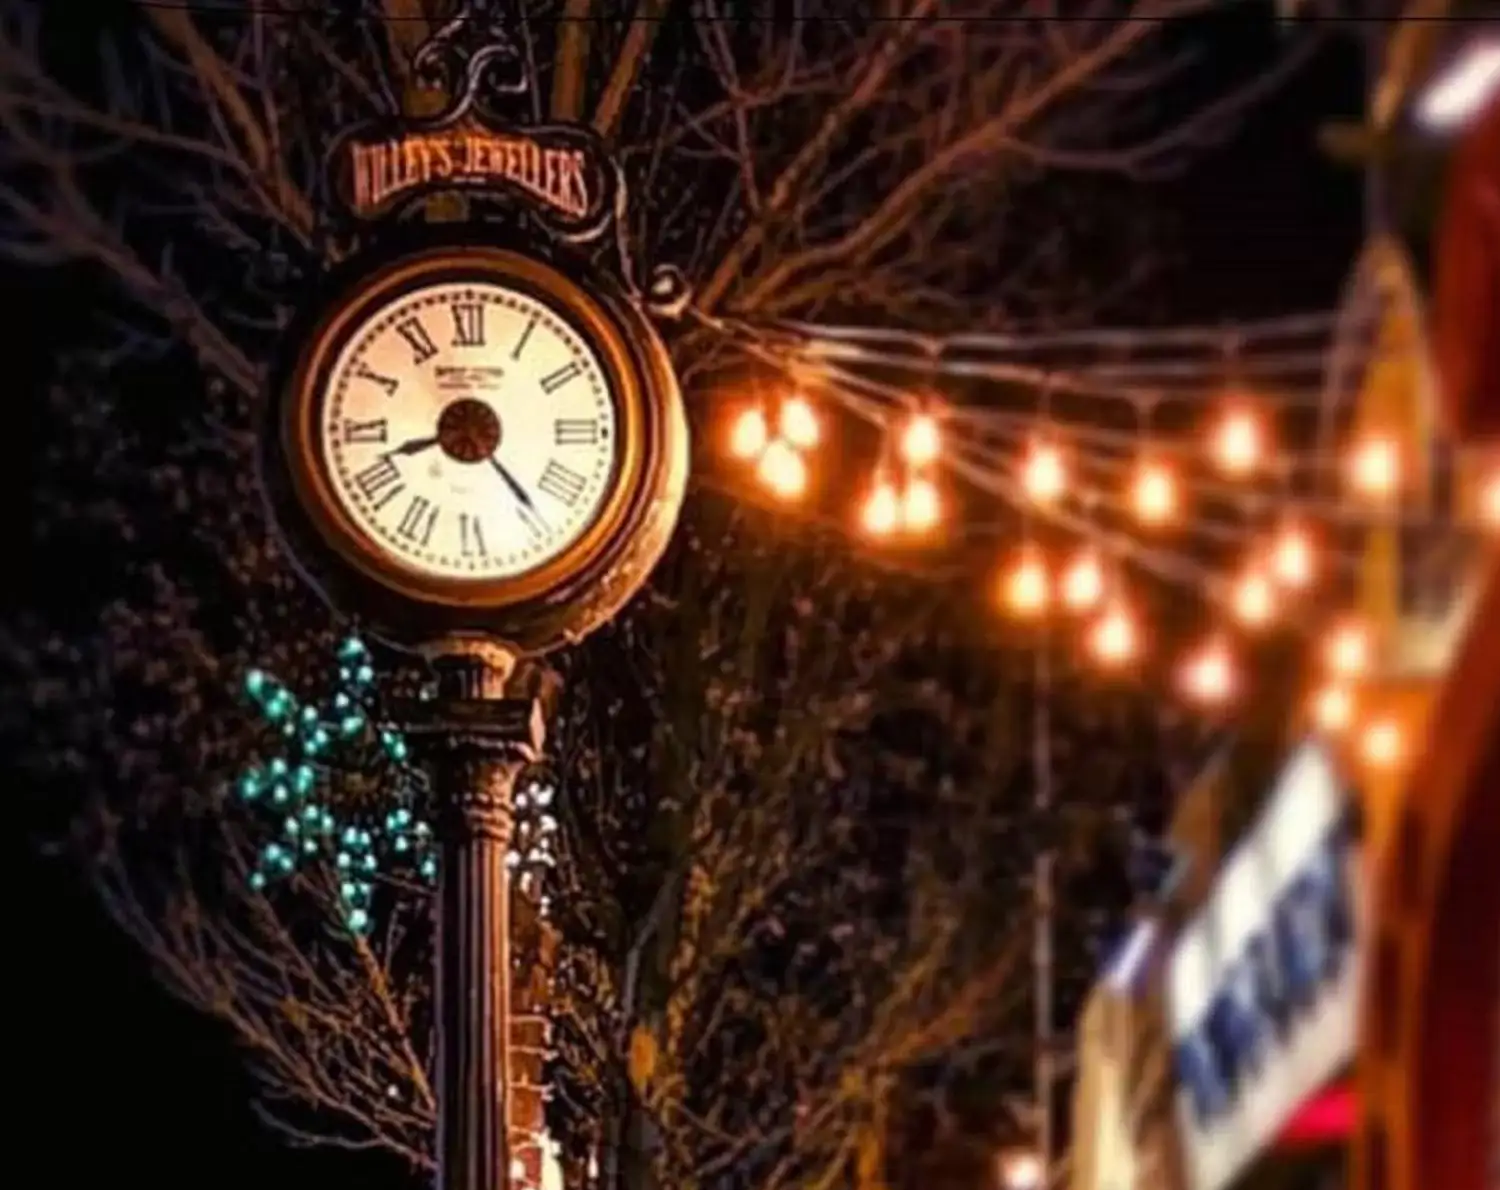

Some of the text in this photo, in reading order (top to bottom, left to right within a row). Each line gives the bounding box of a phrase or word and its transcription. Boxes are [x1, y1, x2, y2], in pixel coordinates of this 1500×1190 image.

[463, 136, 588, 217] JEWELLERS
[396, 317, 438, 365] XI
[452, 303, 486, 347] XII
[513, 318, 538, 360] I
[357, 363, 399, 397] X
[540, 361, 582, 394] II
[345, 418, 388, 445] IX
[555, 419, 599, 446] III
[397, 496, 440, 549] VII
[459, 512, 488, 558] VI
